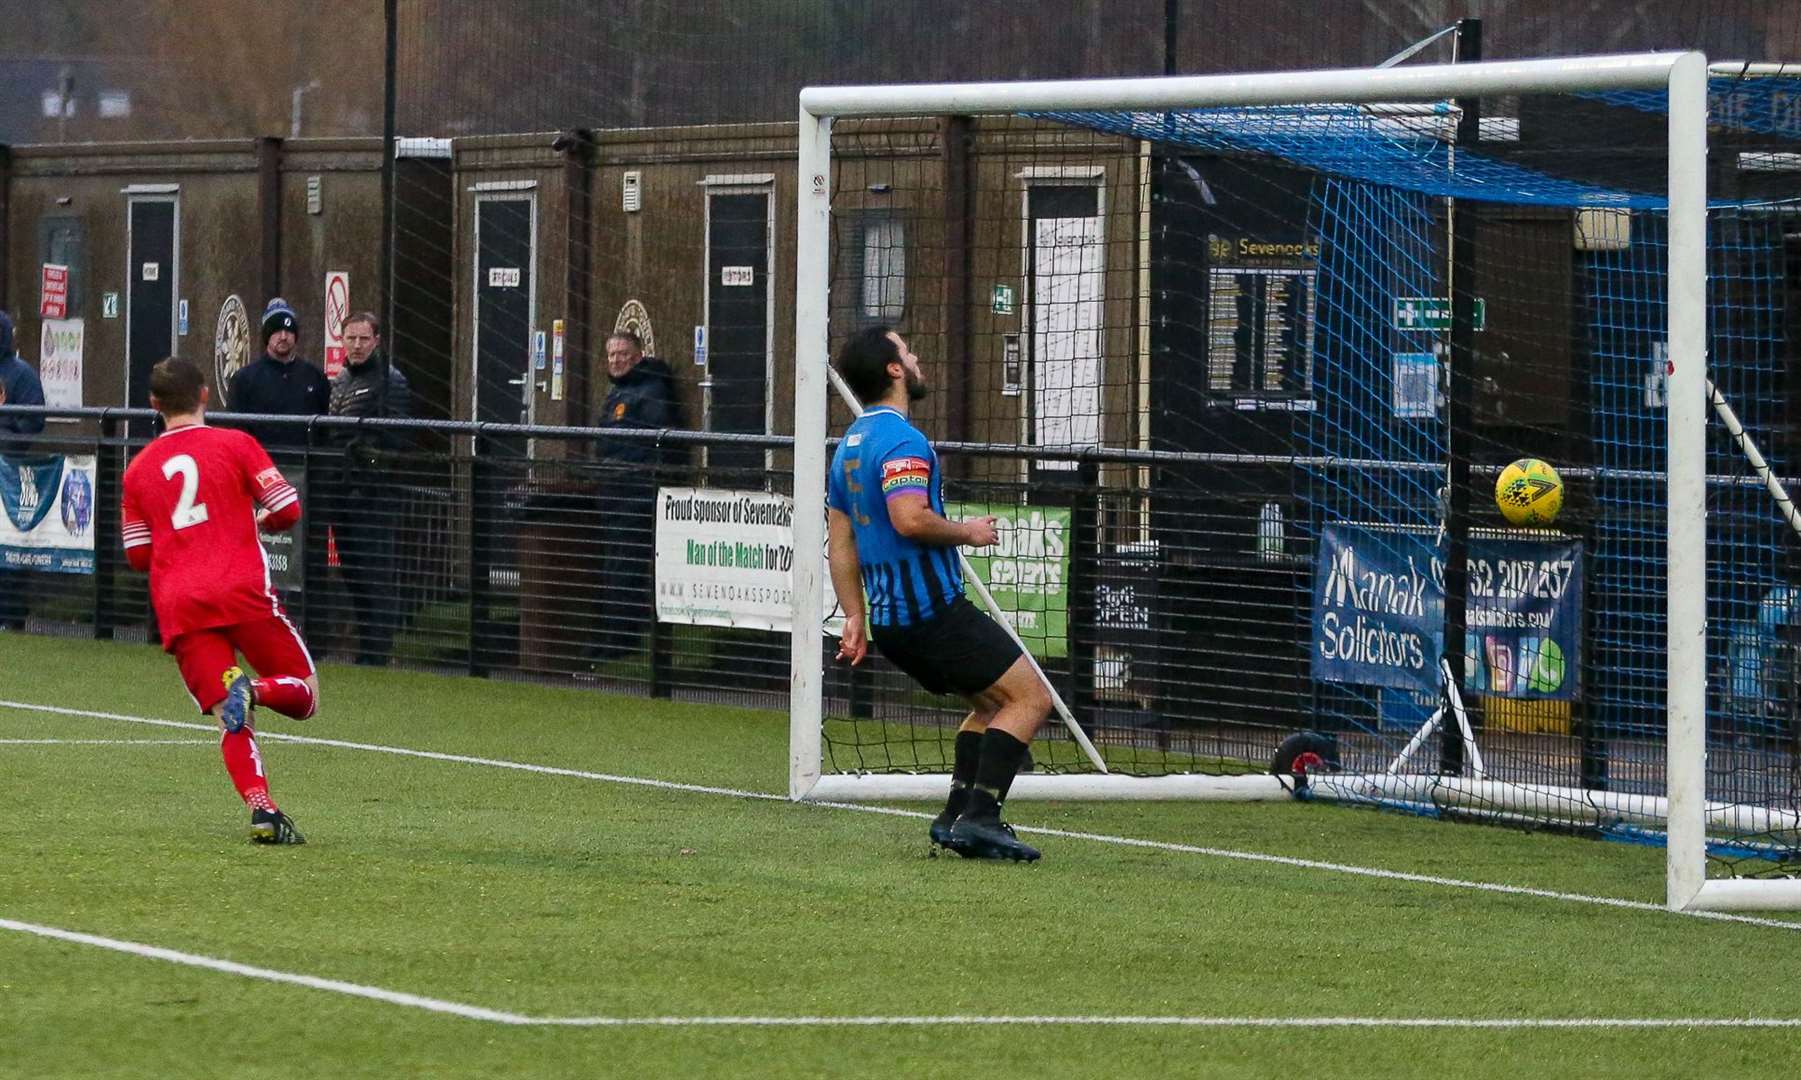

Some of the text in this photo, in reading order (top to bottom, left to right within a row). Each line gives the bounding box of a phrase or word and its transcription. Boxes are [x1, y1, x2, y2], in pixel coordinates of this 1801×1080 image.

[161, 454, 209, 530] 2
[665, 494, 692, 522] Proud
[693, 500, 731, 525] sponsor
[732, 500, 742, 523] of
[686, 539, 706, 566] Man
[707, 542, 717, 567] of
[719, 542, 733, 568] the
[735, 541, 764, 570] Match
[765, 543, 778, 571] for
[1322, 546, 1426, 617] Manak
[1320, 611, 1425, 670] Solicitors
